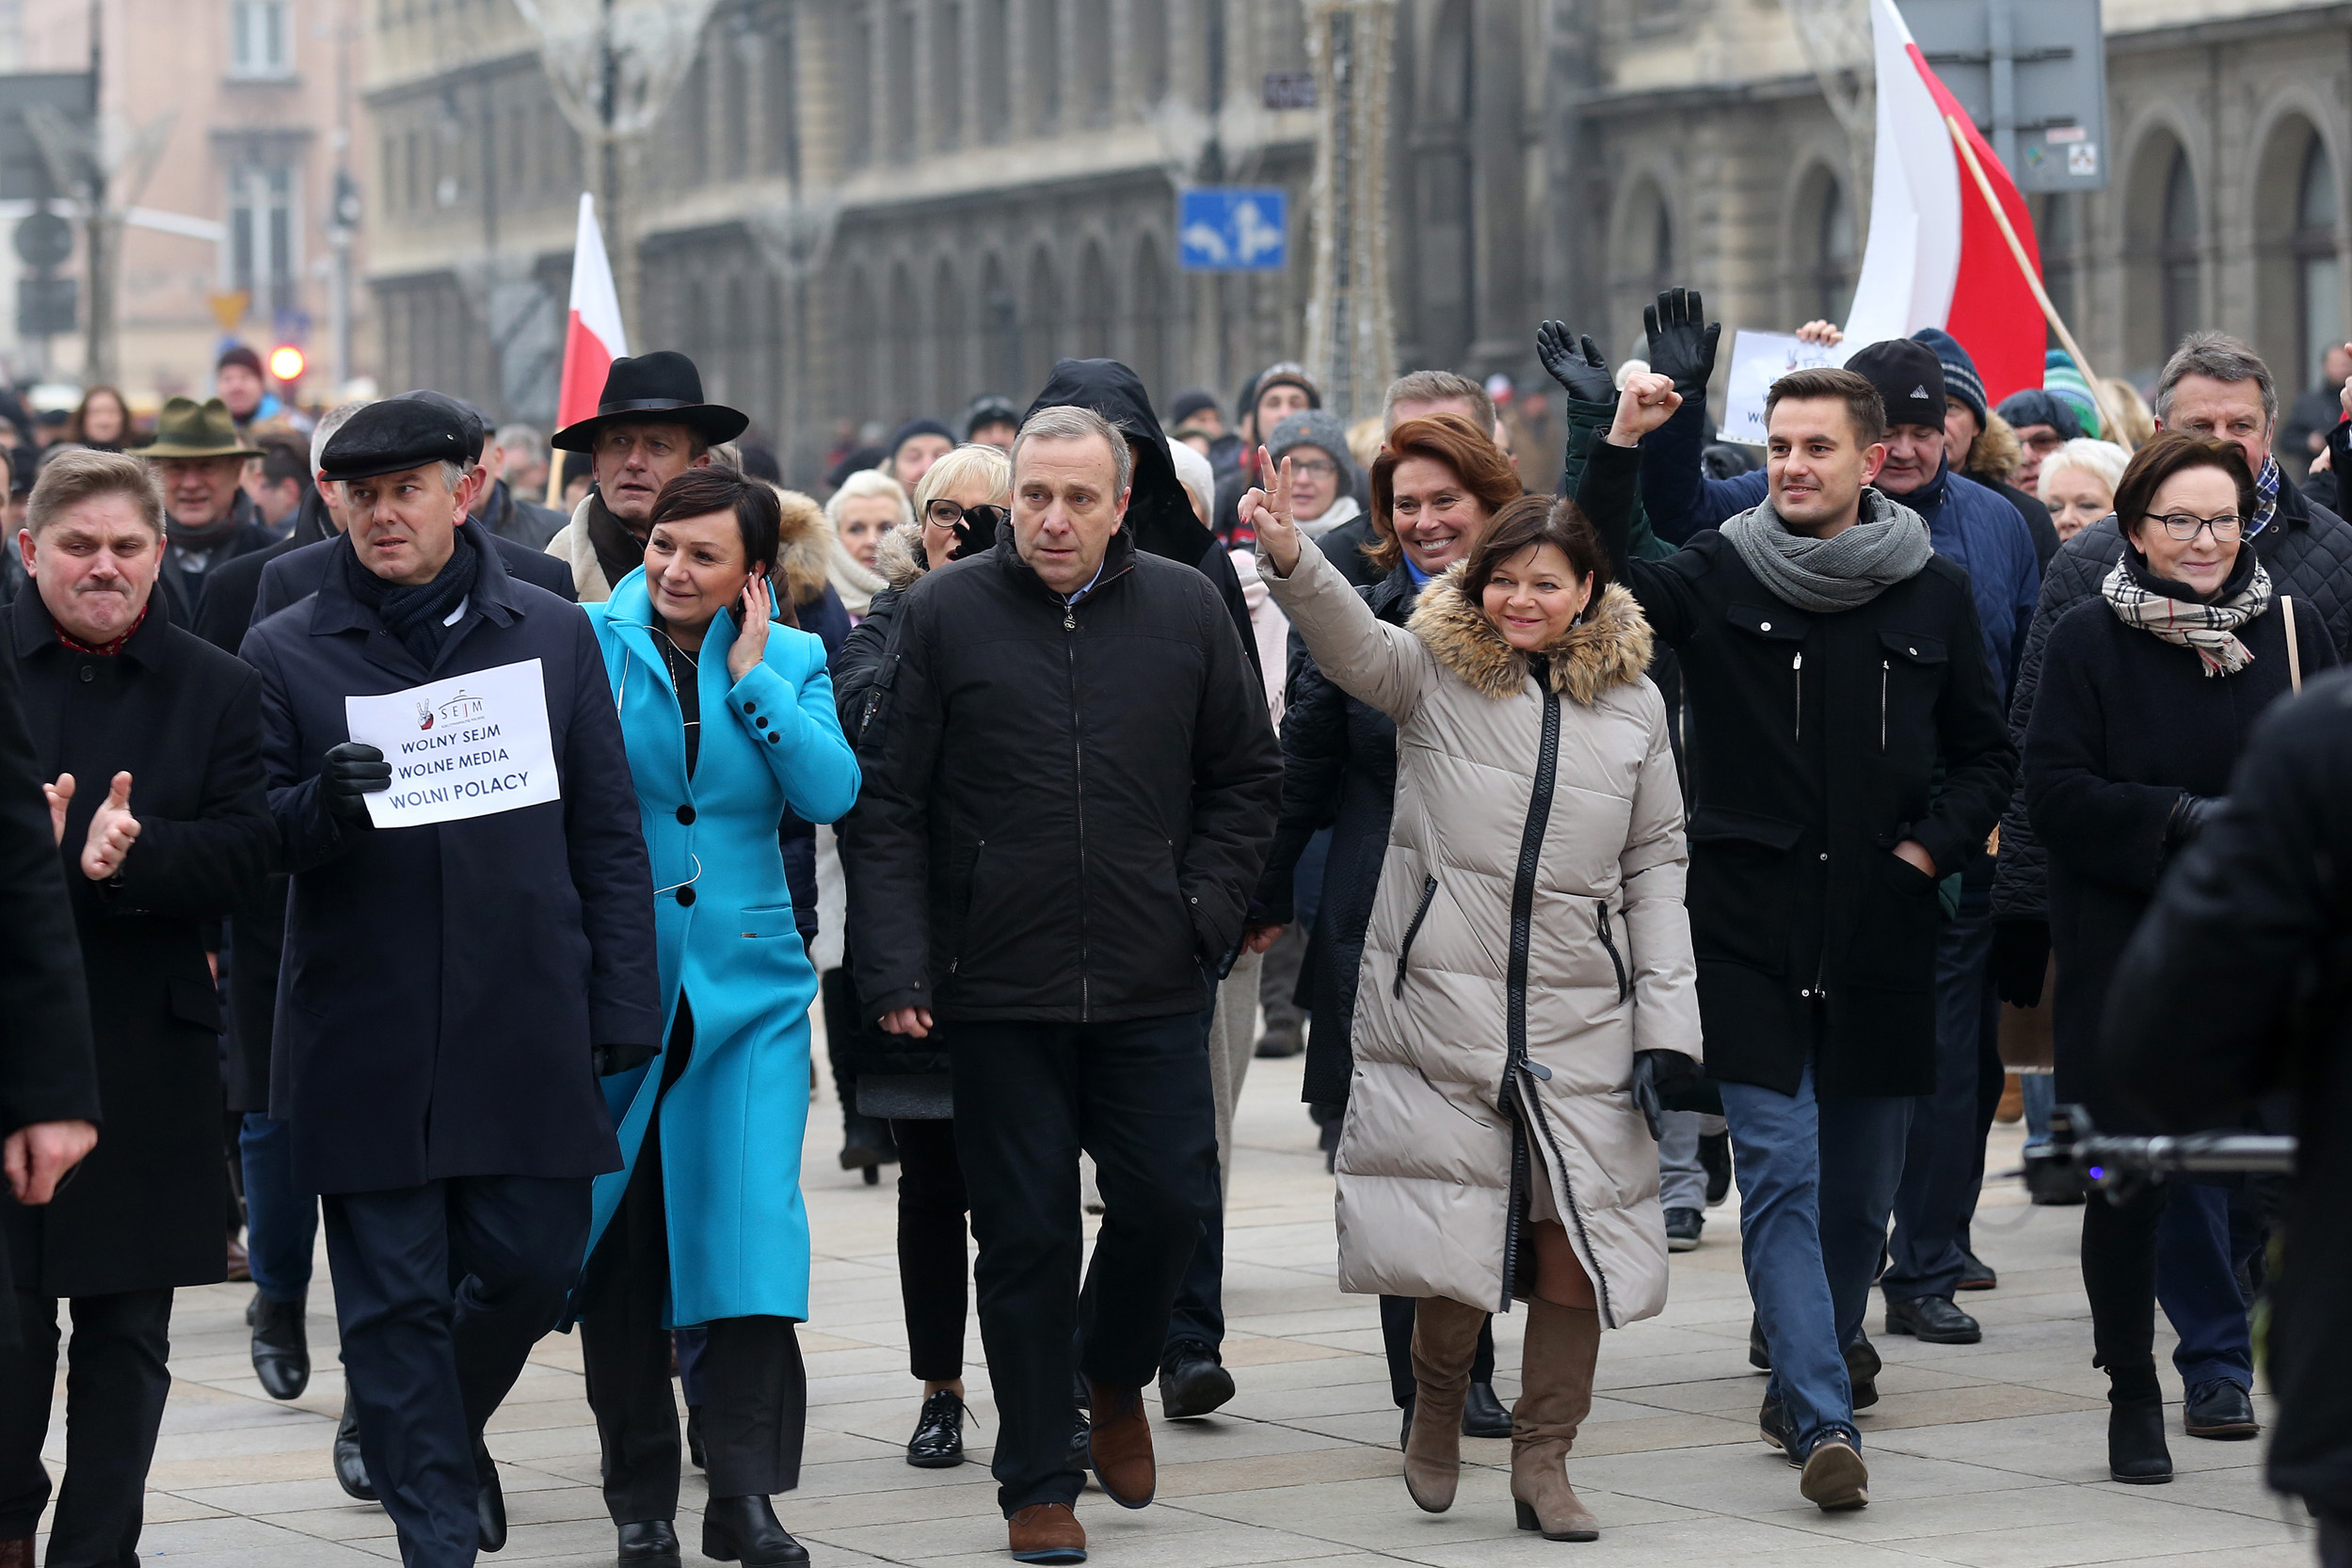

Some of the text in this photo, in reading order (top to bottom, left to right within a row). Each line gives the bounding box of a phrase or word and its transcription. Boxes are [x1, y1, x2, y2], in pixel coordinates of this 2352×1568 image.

[441, 700, 483, 720] SEJM
[402, 724, 501, 754] WOLNY SEJM
[398, 748, 509, 779] WOLNE MEDIA
[389, 772, 529, 809] WOLNI POLACY
